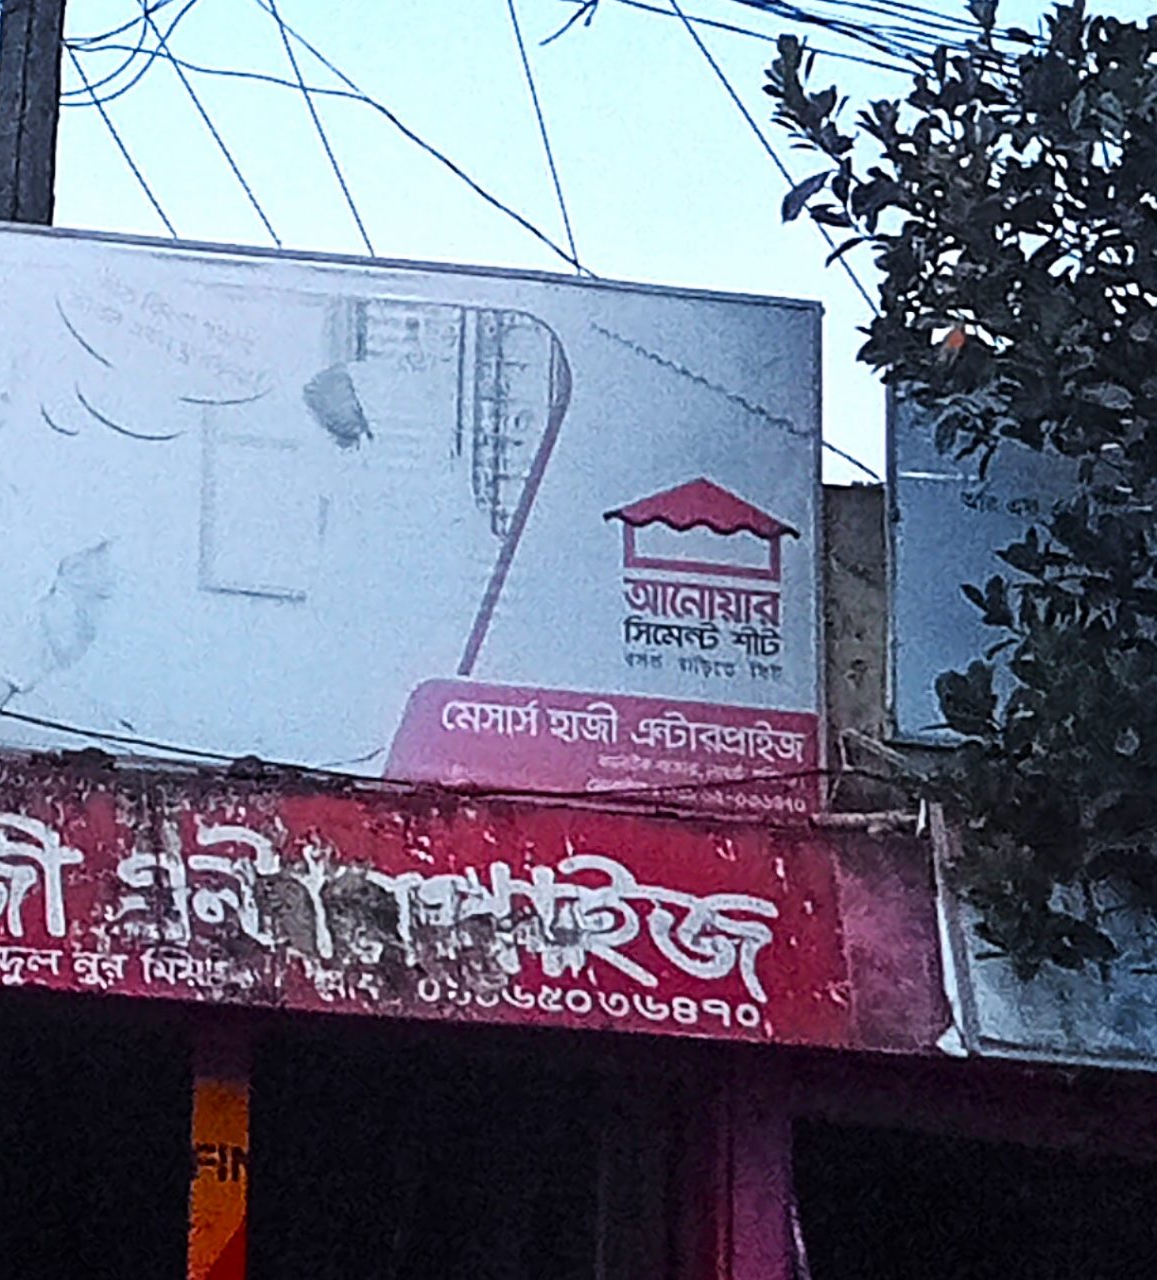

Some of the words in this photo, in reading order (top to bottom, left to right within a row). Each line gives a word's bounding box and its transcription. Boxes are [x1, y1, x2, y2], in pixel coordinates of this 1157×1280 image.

[623, 577, 781, 627] আনোয়ার
[623, 616, 720, 651] সিমেন্ট
[732, 627, 782, 658] শীট
[442, 700, 539, 738] মেসার্স
[546, 701, 619, 745] হাজী
[630, 710, 806, 764] এন্টারপ্রাইজ
